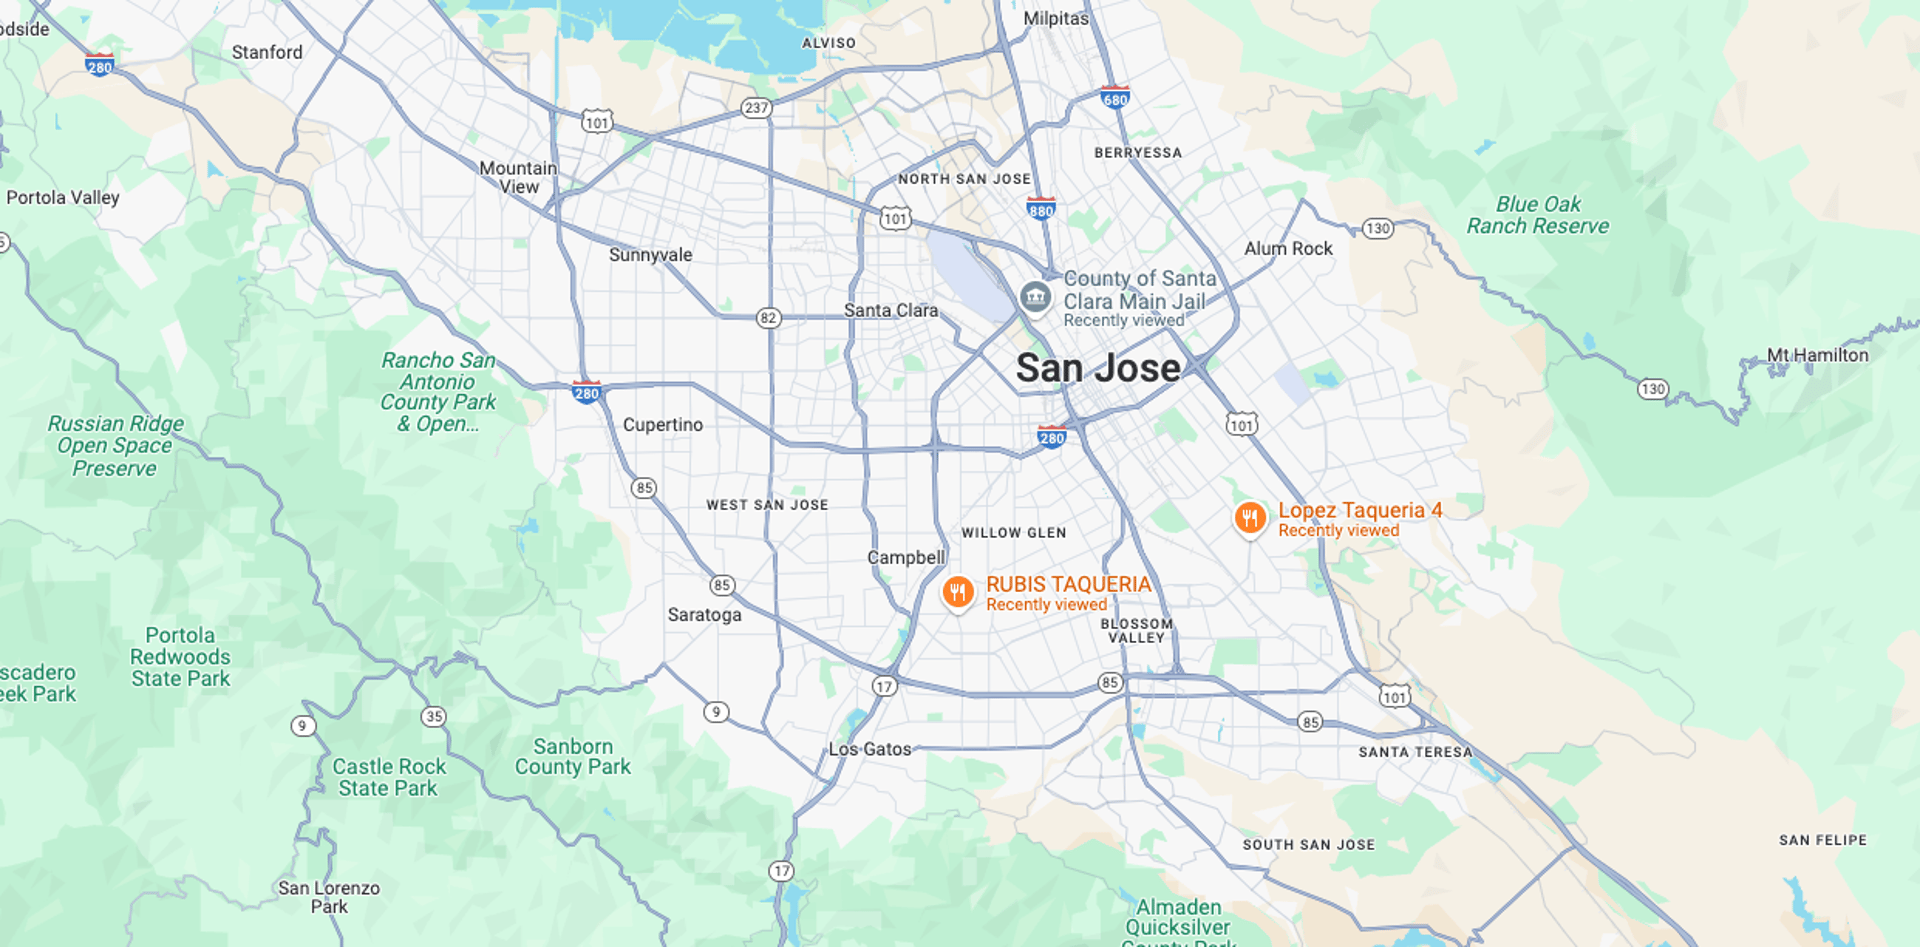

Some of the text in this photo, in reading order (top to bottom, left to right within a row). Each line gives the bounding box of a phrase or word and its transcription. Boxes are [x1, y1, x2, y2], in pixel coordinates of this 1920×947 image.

[1024, 10, 1089, 29] Milpitas
[802, 37, 856, 49] ALVISO
[232, 44, 303, 60] Stanford
[87, 61, 113, 75] 280
[745, 102, 768, 114] 237
[1103, 94, 1129, 107] 680
[586, 118, 607, 129] 101
[1095, 147, 1182, 159] BERRYESSA
[480, 160, 557, 176] Mountain
[499, 179, 540, 194] View
[898, 173, 1032, 185] NORTH SAN JOSE
[7, 189, 120, 208] Portola Valley
[1496, 195, 1582, 213] Blue Oak
[885, 213, 906, 225] 101
[1029, 205, 1055, 218] 880
[1367, 223, 1390, 234] 130
[1466, 216, 1610, 234] Ranch Reserve
[609, 246, 693, 265] Sunnyvale
[1244, 240, 1334, 256] Alum Rock
[1064, 268, 1217, 291] County of Santa
[1064, 292, 1205, 310] Clara Main Jail
[761, 312, 776, 324] 82
[844, 302, 939, 318] Santa Clara
[1064, 313, 1185, 330] Recently viewed
[381, 351, 496, 369] Rancho San
[1767, 347, 1869, 363] Mt Hamilton
[1016, 351, 1181, 383] San Jose
[398, 373, 475, 390] Antonio
[1642, 383, 1664, 395] 130
[575, 387, 600, 400] 280
[381, 392, 497, 415] County Park
[47, 414, 185, 436] Russian Ridge
[397, 414, 410, 432] &
[623, 416, 704, 435] Cupertino
[1231, 420, 1252, 432] 101
[1040, 432, 1065, 445] 280
[58, 436, 173, 458] Open Space
[72, 459, 157, 477] Preserve
[637, 482, 653, 494] 85
[706, 499, 829, 511] WEST SAN JOSE
[1279, 501, 1443, 523] Lopez Taqueria 4
[961, 527, 1066, 539] WILLOW GLEN
[1279, 523, 1400, 540] Recently viewed
[868, 549, 945, 568] Campbell
[714, 579, 730, 591] 85
[987, 575, 1153, 595] RUBIS TAQUERIA
[987, 597, 1108, 615] Recently viewed
[668, 606, 742, 625] Saratoga
[1101, 618, 1173, 630] BLOSSOM
[146, 626, 215, 644] Portola
[1108, 632, 1165, 644] VALLEY
[130, 647, 231, 665] Redwoods
[132, 669, 231, 687] State Park
[1102, 677, 1118, 688] 85
[33, 684, 77, 702] Park
[877, 681, 892, 693] 17
[1384, 692, 1405, 704] 101
[426, 710, 443, 723] 35
[712, 706, 721, 718] 9
[298, 720, 306, 732] 9
[1303, 717, 1319, 729] 85
[534, 737, 613, 755] Sanborn
[829, 741, 912, 757] Los Gatos
[1359, 746, 1473, 758] SANTA TERESA
[333, 757, 447, 775] Castle Rock
[515, 757, 632, 779] County Park
[339, 779, 438, 797] State Park
[1243, 839, 1375, 851] SOUTH SAN JOSE
[1779, 834, 1867, 846] SAN FELIPE
[775, 865, 790, 877] 17
[279, 880, 380, 896] San Lorenzo
[311, 898, 349, 914] Park
[1136, 898, 1222, 916] Almaden
[1126, 917, 1231, 937] Quicksilver
